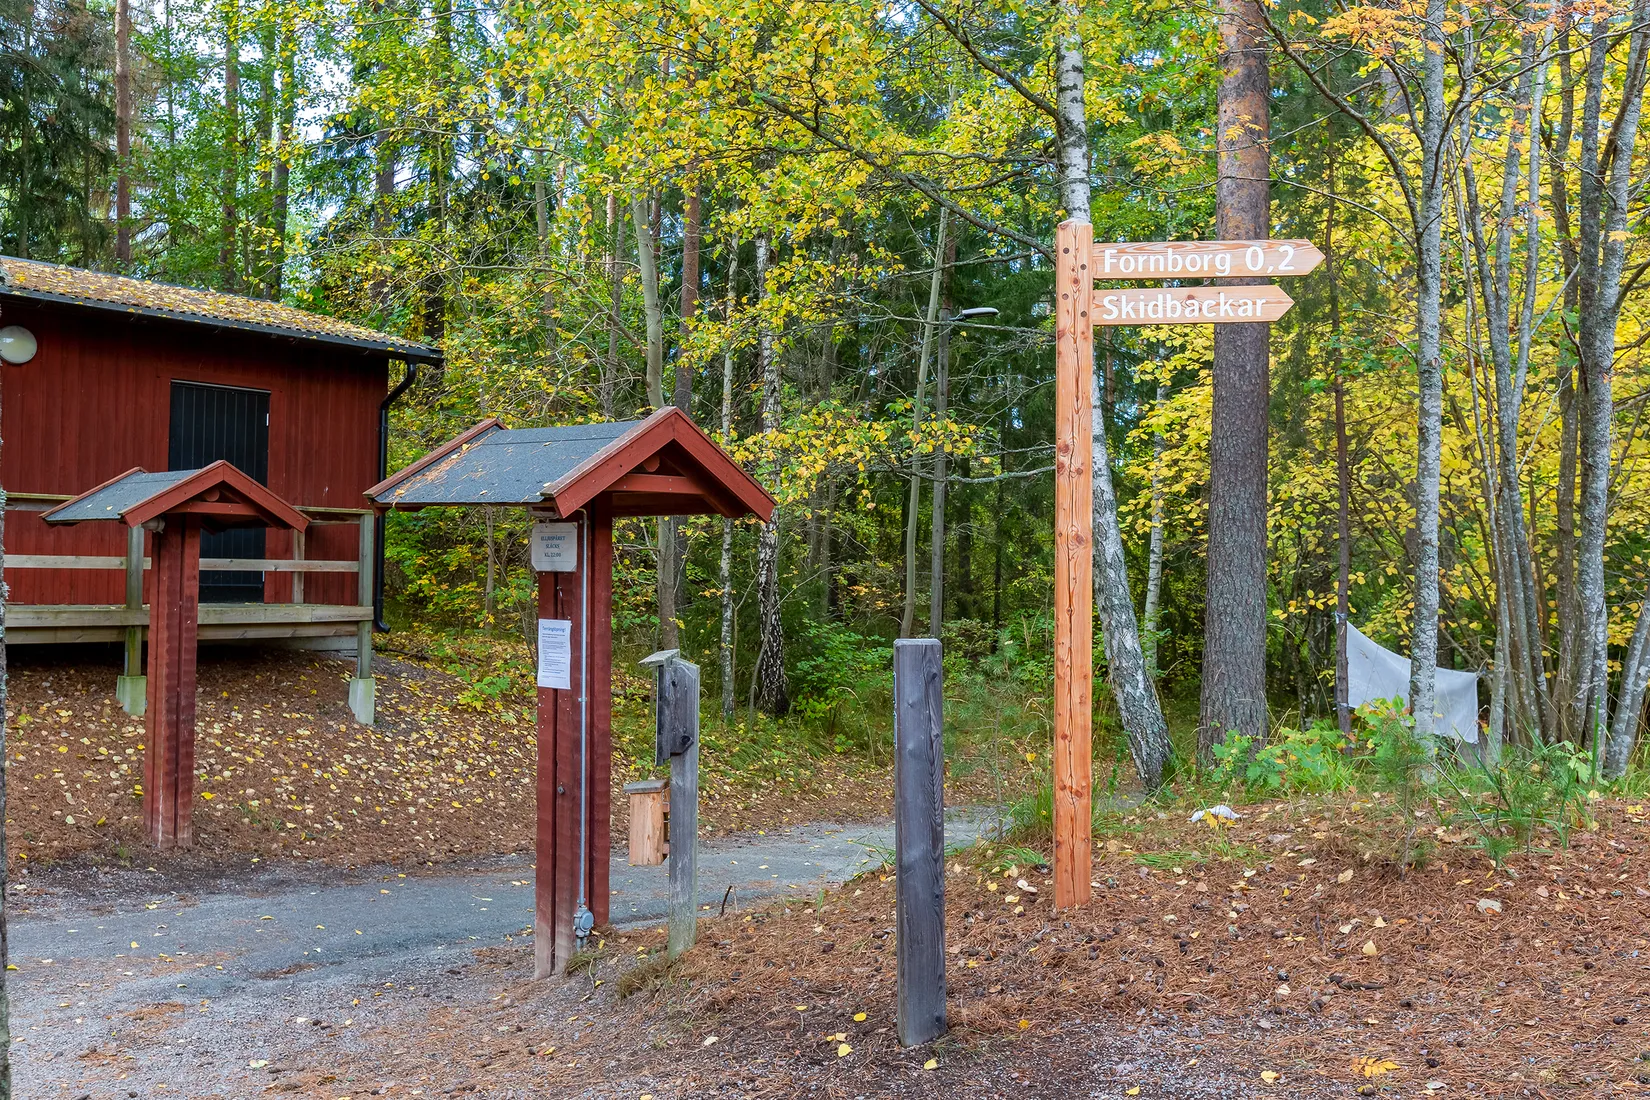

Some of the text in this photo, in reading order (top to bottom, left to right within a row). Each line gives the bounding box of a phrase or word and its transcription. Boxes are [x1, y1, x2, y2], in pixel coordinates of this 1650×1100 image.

[1103, 245, 1295, 276] Fornborg 0,2
[1102, 292, 1267, 320] Skidbackar
